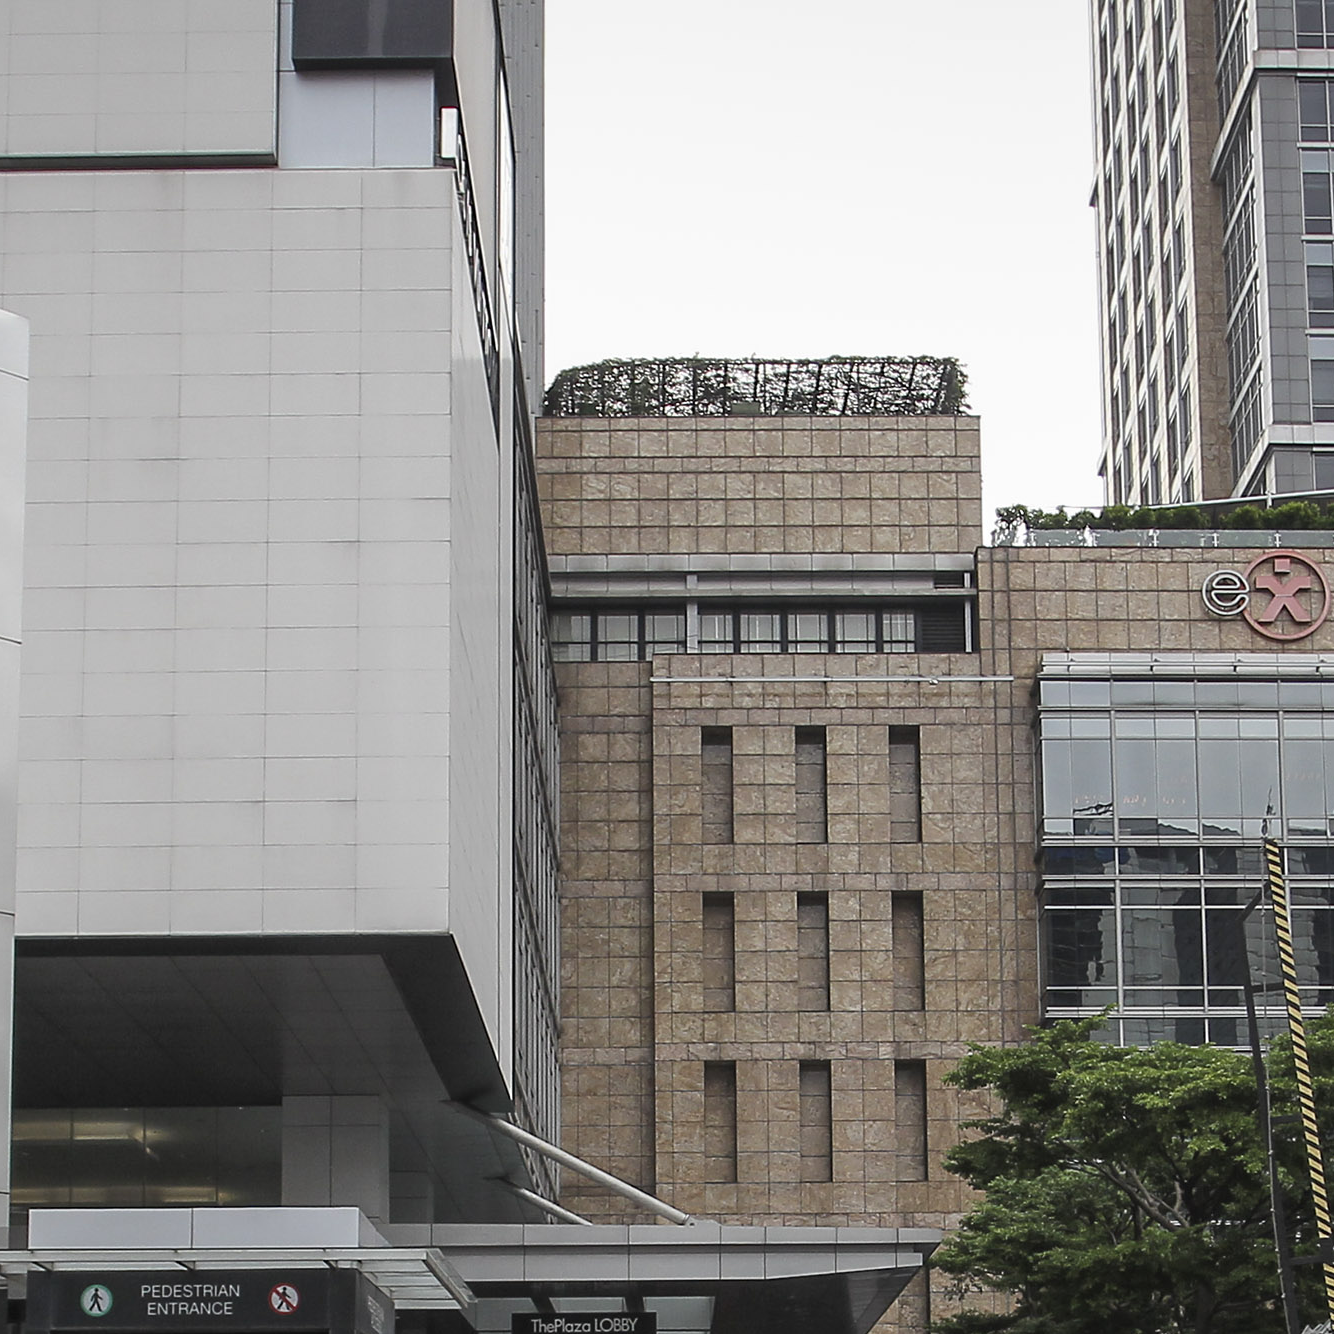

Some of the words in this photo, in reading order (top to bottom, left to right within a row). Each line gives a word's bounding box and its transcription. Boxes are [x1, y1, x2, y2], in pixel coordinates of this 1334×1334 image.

[140, 1284, 241, 1298] PEDESTRIAN
[147, 1301, 234, 1316] ENTRANCE
[594, 1317, 639, 1333] LOBBY
